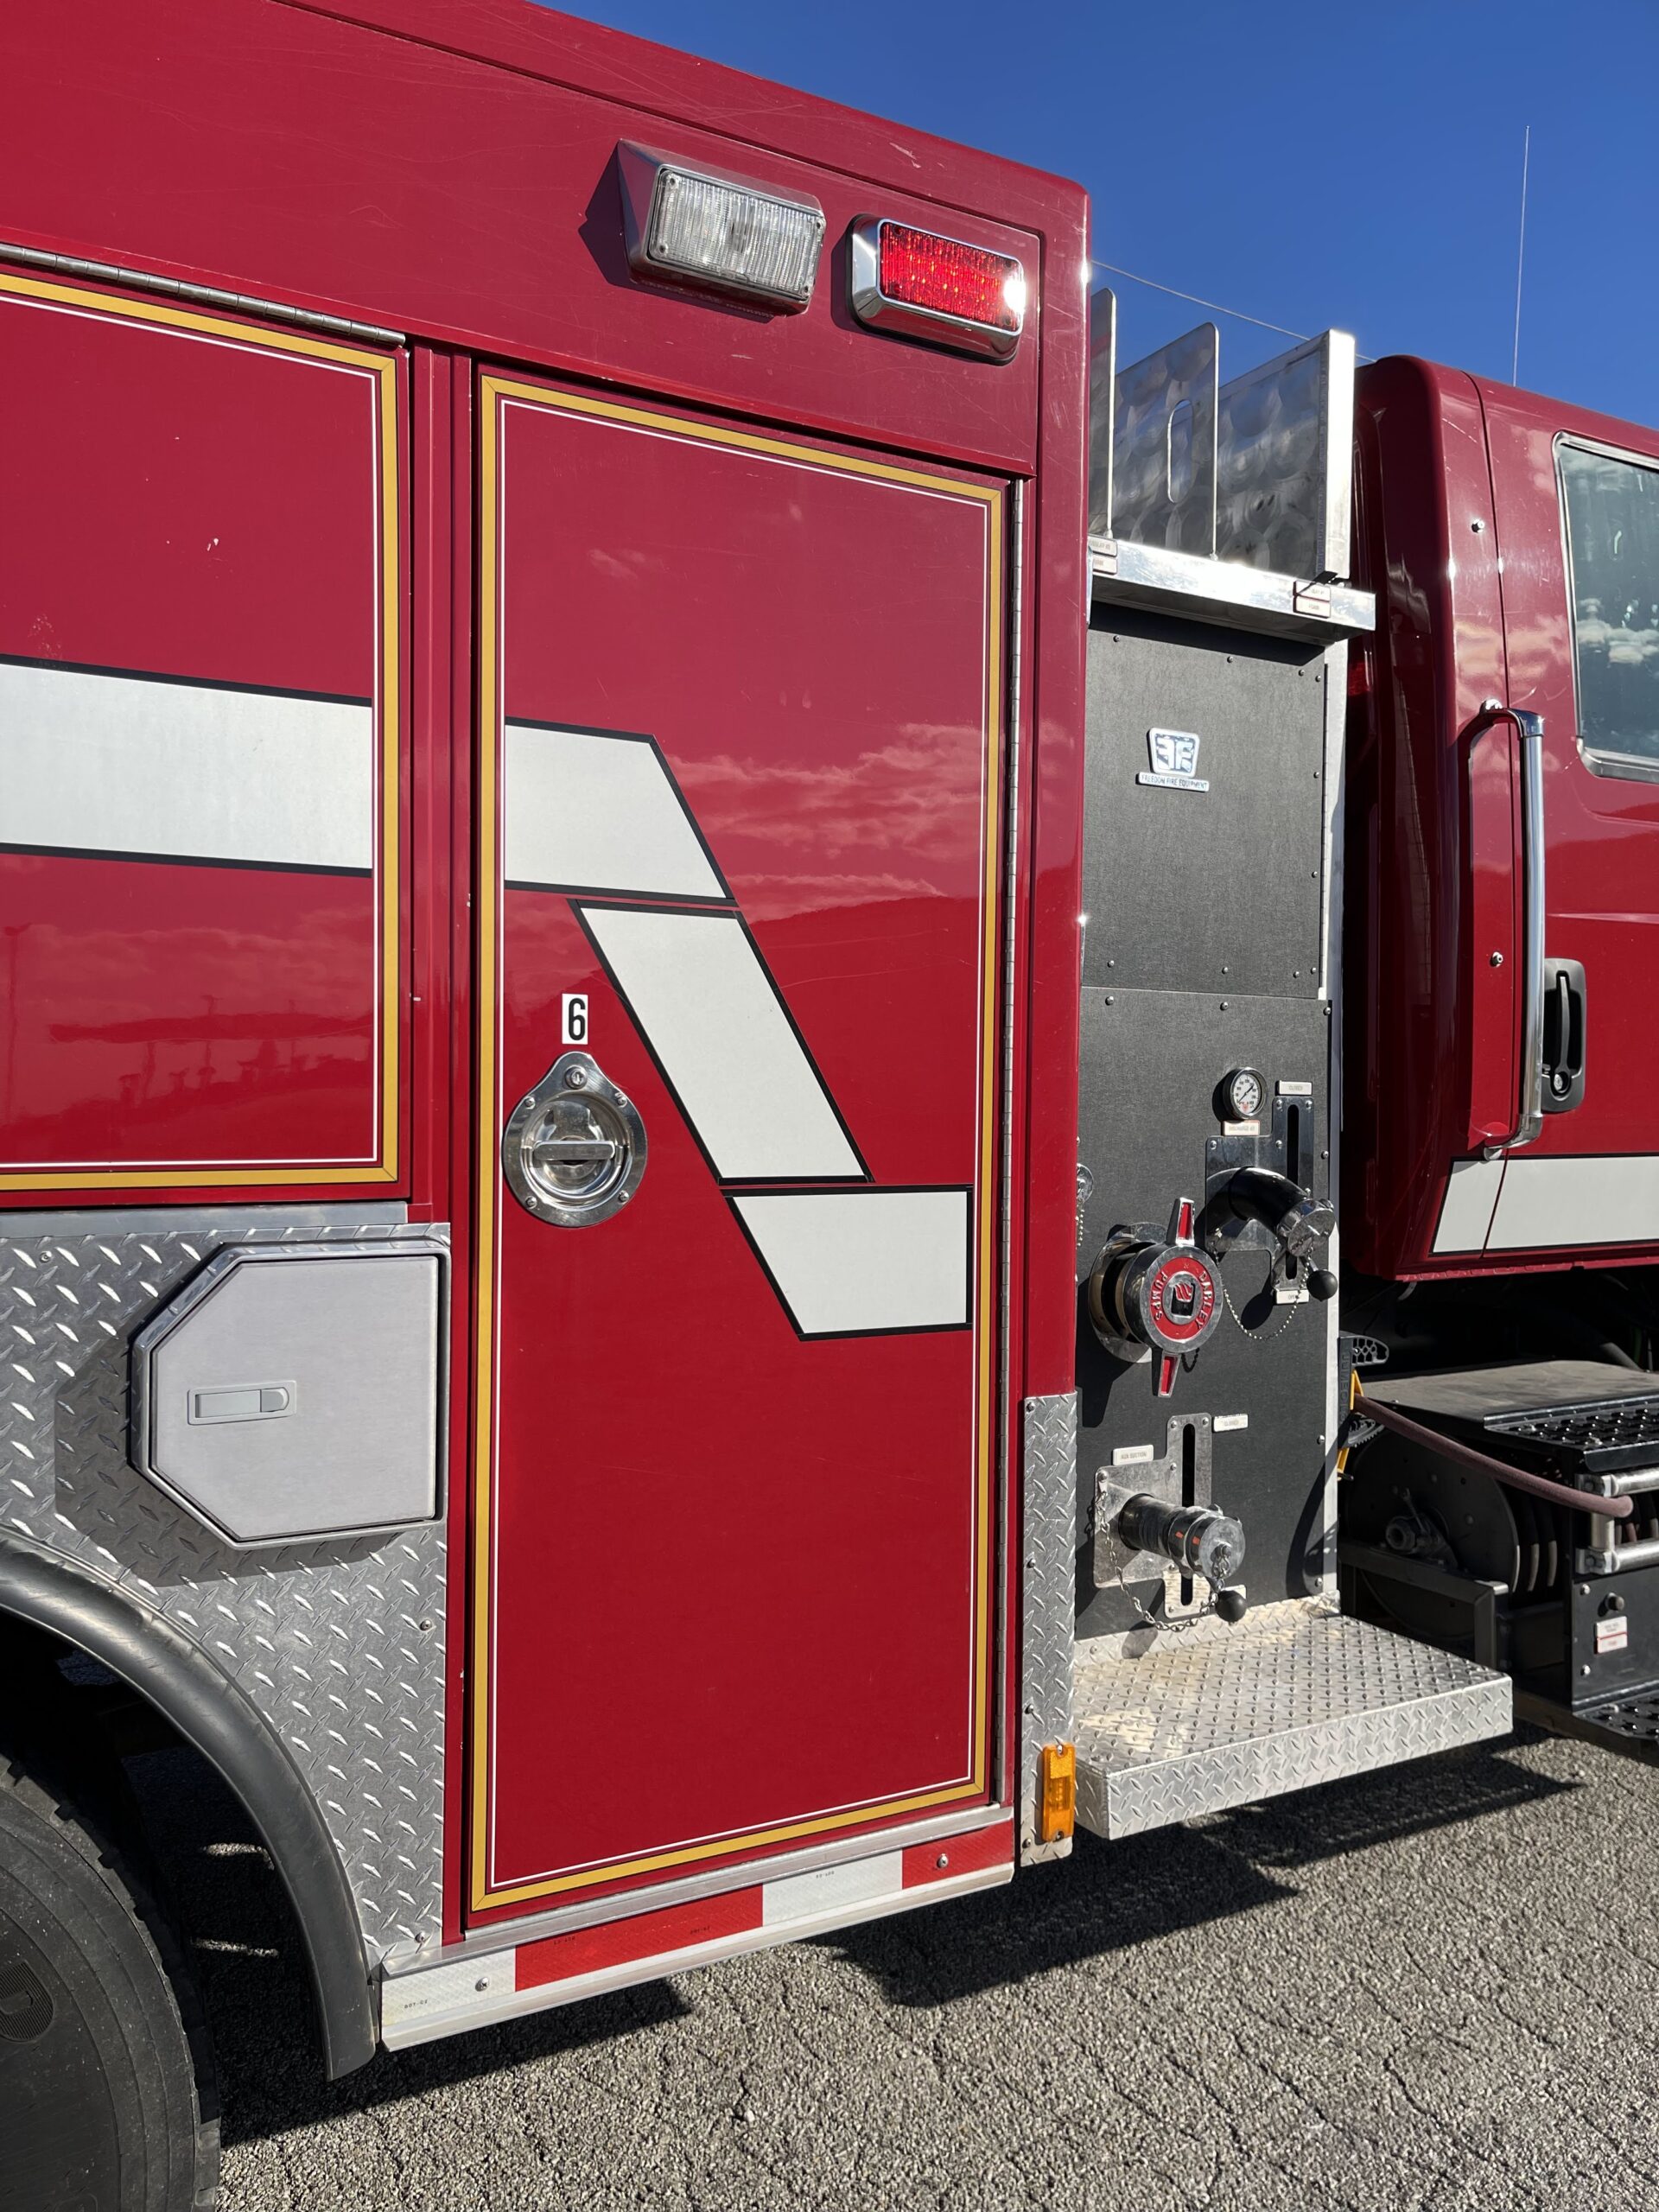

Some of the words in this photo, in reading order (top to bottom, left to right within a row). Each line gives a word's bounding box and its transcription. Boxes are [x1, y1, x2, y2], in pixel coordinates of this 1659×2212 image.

[1141, 774, 1166, 785] FREEDOM
[1166, 778, 1179, 786] FIRE
[1179, 779, 1208, 790] EQUIPMENT
[569, 997, 586, 1040] 6
[1151, 1271, 1169, 1320] PUMPS
[1196, 1270, 1213, 1331] DARLEY
